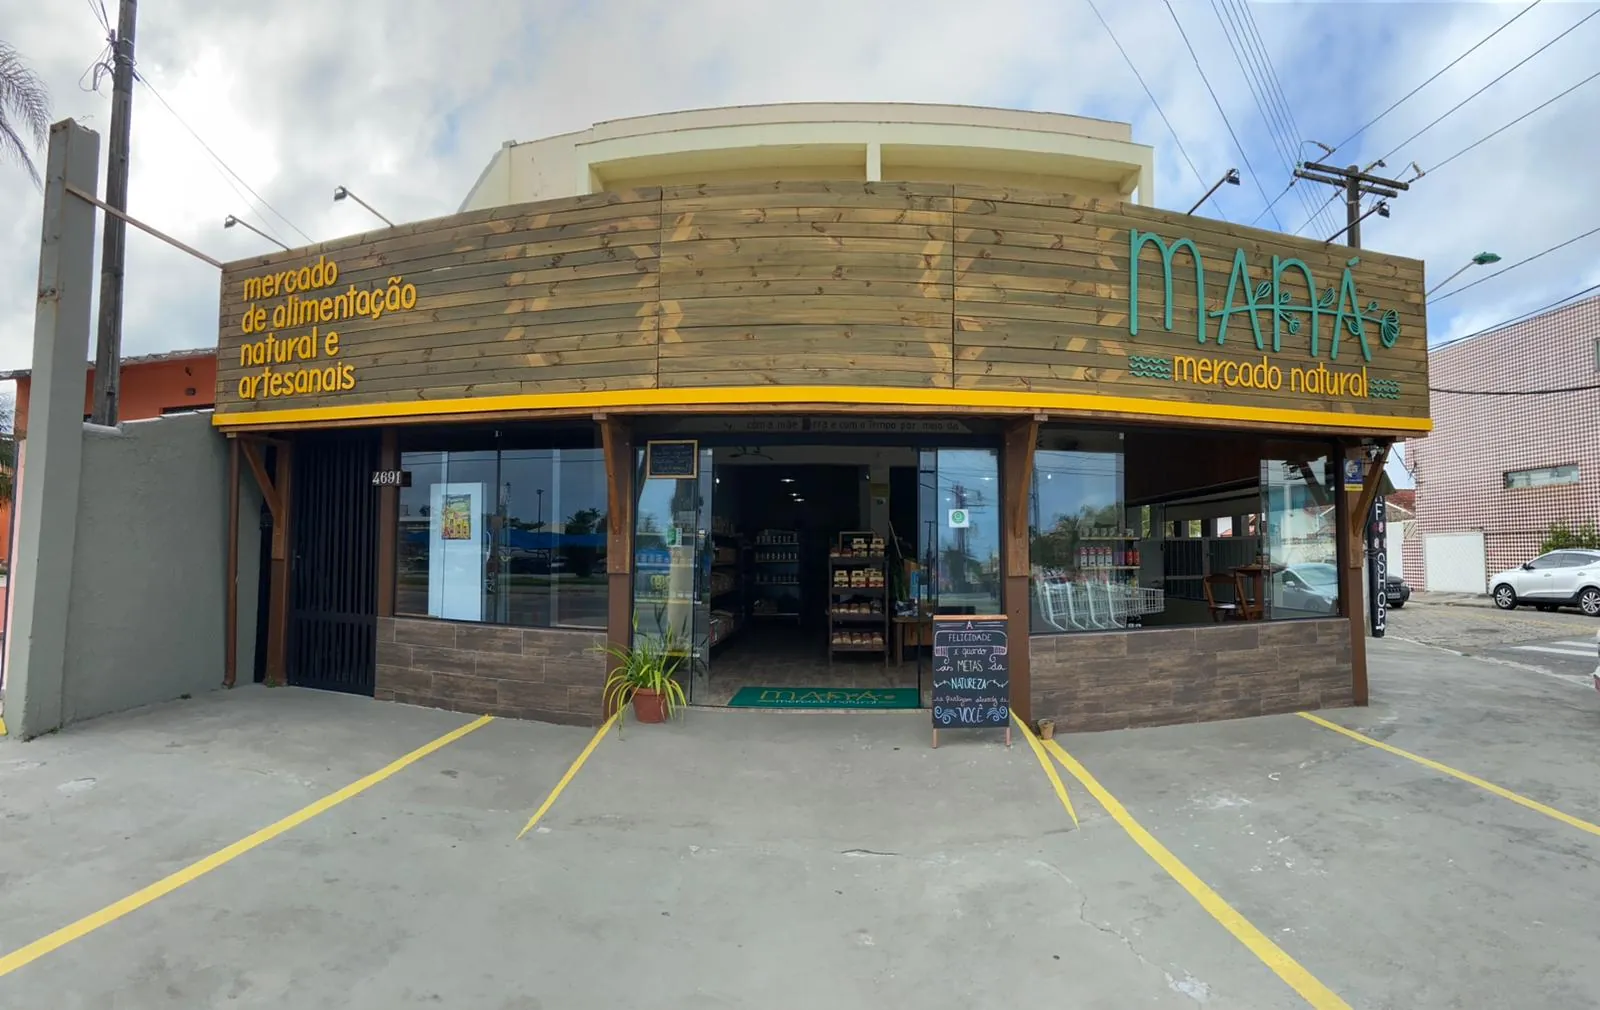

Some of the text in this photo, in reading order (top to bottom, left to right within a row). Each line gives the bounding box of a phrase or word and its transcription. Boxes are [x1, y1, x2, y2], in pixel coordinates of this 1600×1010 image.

[243, 255, 339, 302] mercado
[1129, 228, 1371, 362] MANÁ
[242, 276, 417, 334] de alimentação
[240, 326, 340, 367] natural e
[238, 361, 357, 399] artesanais
[1173, 355, 1368, 398] mercado natural
[372, 471, 401, 484] 4691
[1377, 552, 1386, 624] SHOP
[948, 633, 992, 642] FELICIDADE
[966, 620, 974, 629] A
[950, 677, 987, 690] NATUREZA
[957, 659, 984, 673] METAS
[956, 704, 984, 723] VOCÊ
